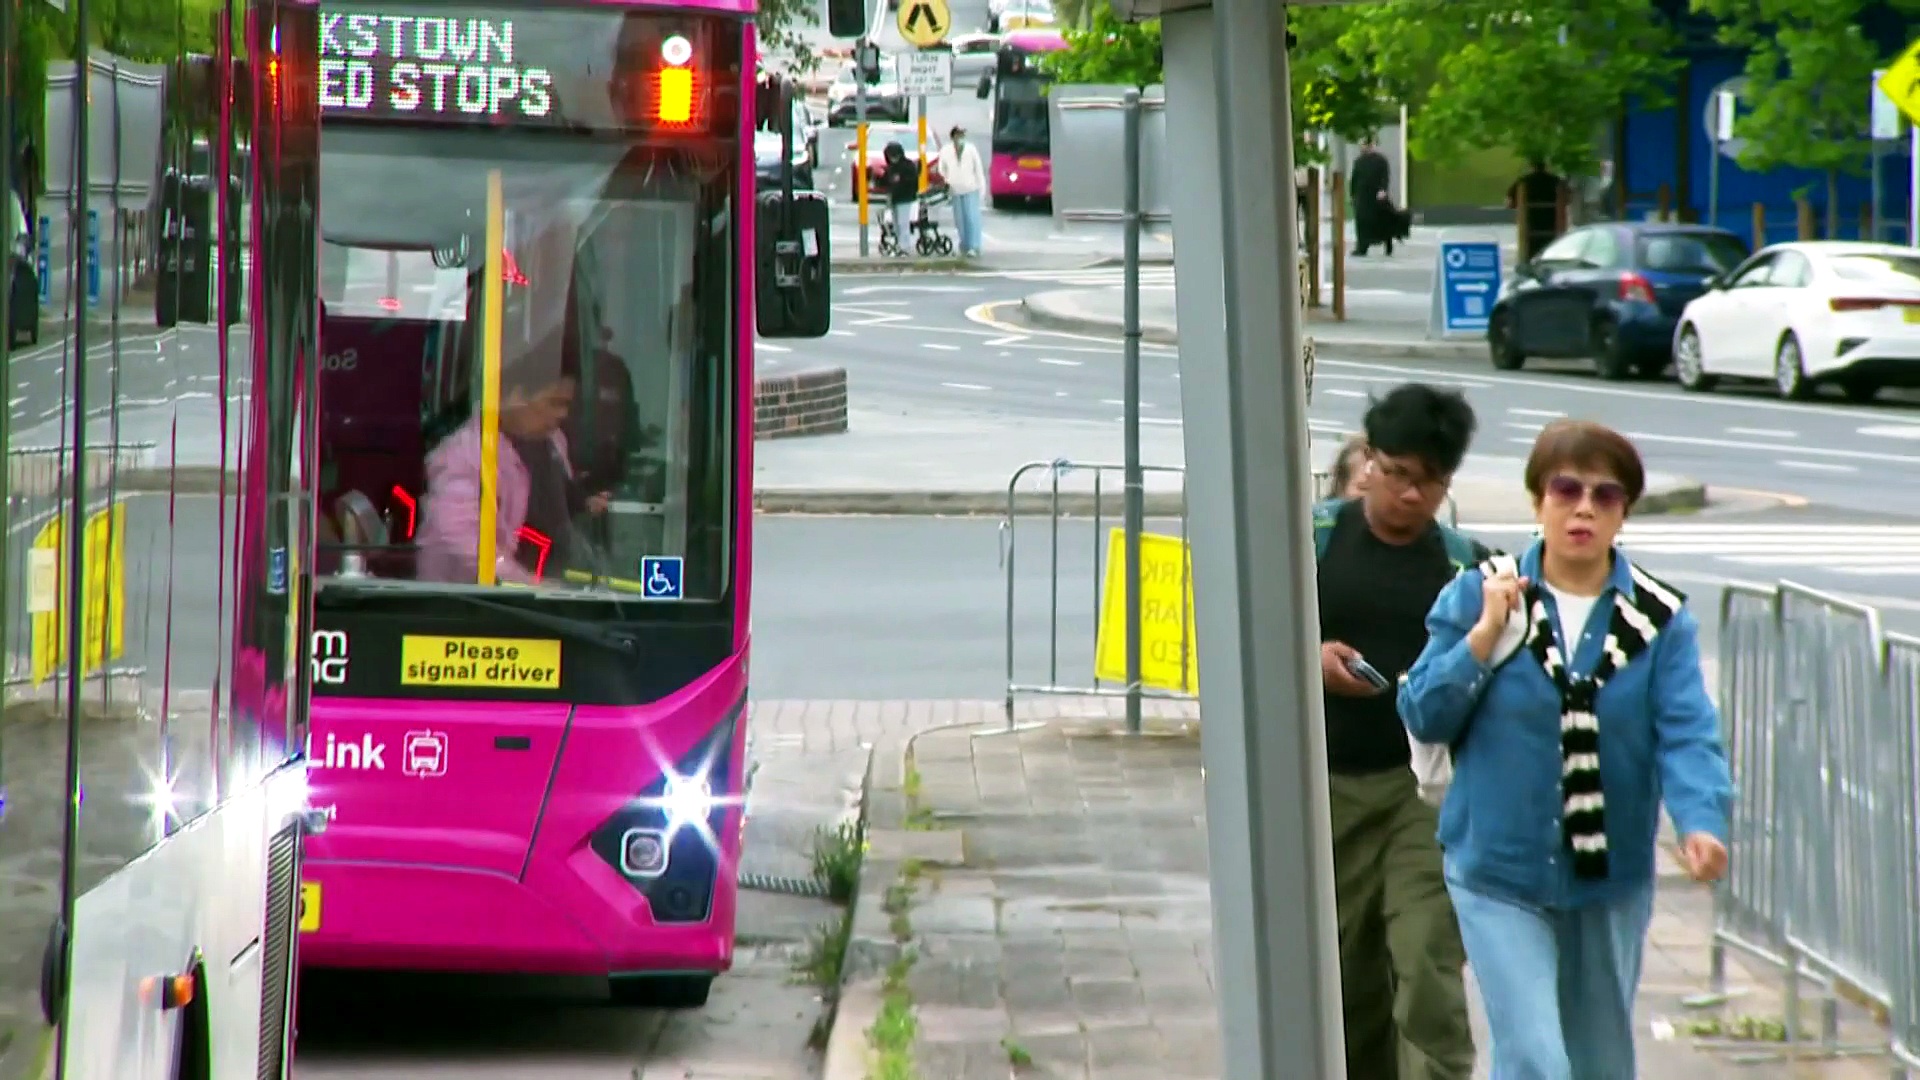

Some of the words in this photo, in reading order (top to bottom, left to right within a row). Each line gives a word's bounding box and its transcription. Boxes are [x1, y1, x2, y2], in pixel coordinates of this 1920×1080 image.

[319, 13, 514, 63] KSTOWN
[318, 59, 374, 108] ED
[389, 62, 553, 117] STOPS
[445, 641, 520, 660] Please
[407, 660, 477, 682] signal
[485, 662, 556, 682] driver
[305, 731, 387, 771] Link
